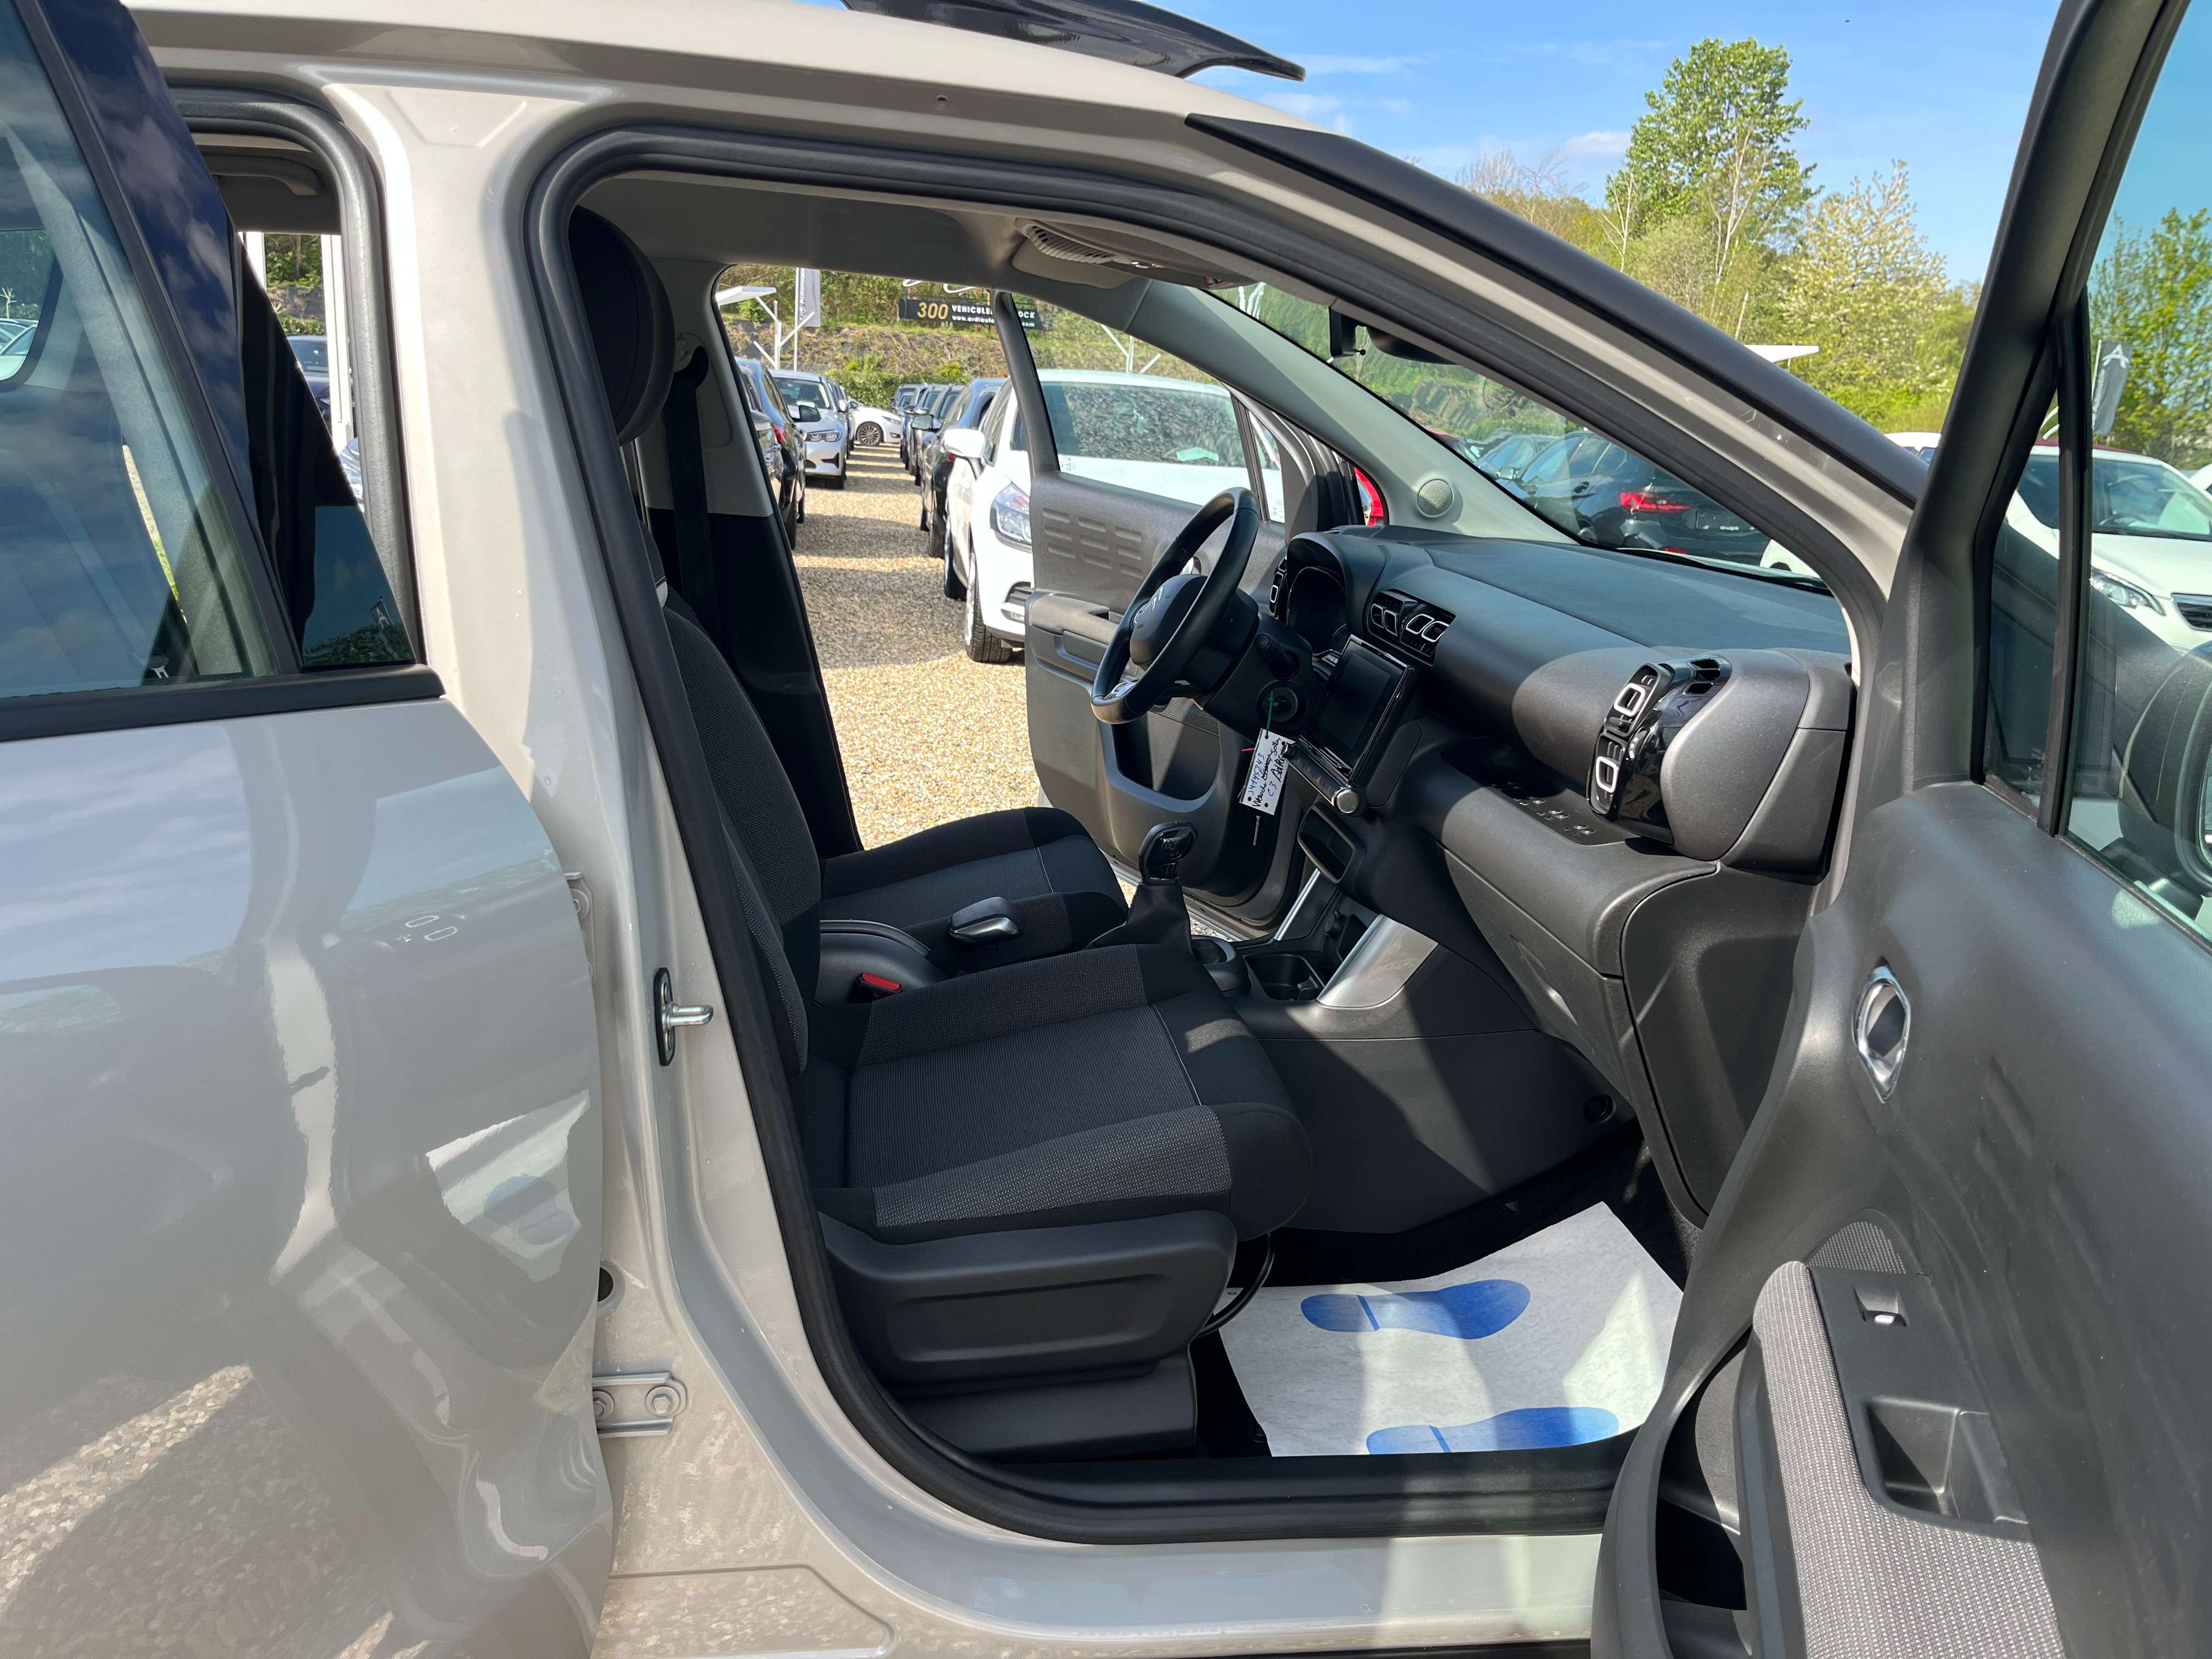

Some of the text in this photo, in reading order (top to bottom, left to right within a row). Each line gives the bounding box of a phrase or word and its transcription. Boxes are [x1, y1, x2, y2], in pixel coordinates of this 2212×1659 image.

[917, 302, 949, 320] 300
[951, 304, 993, 315] VEHICULE
[951, 315, 995, 324] www.ardiauto
